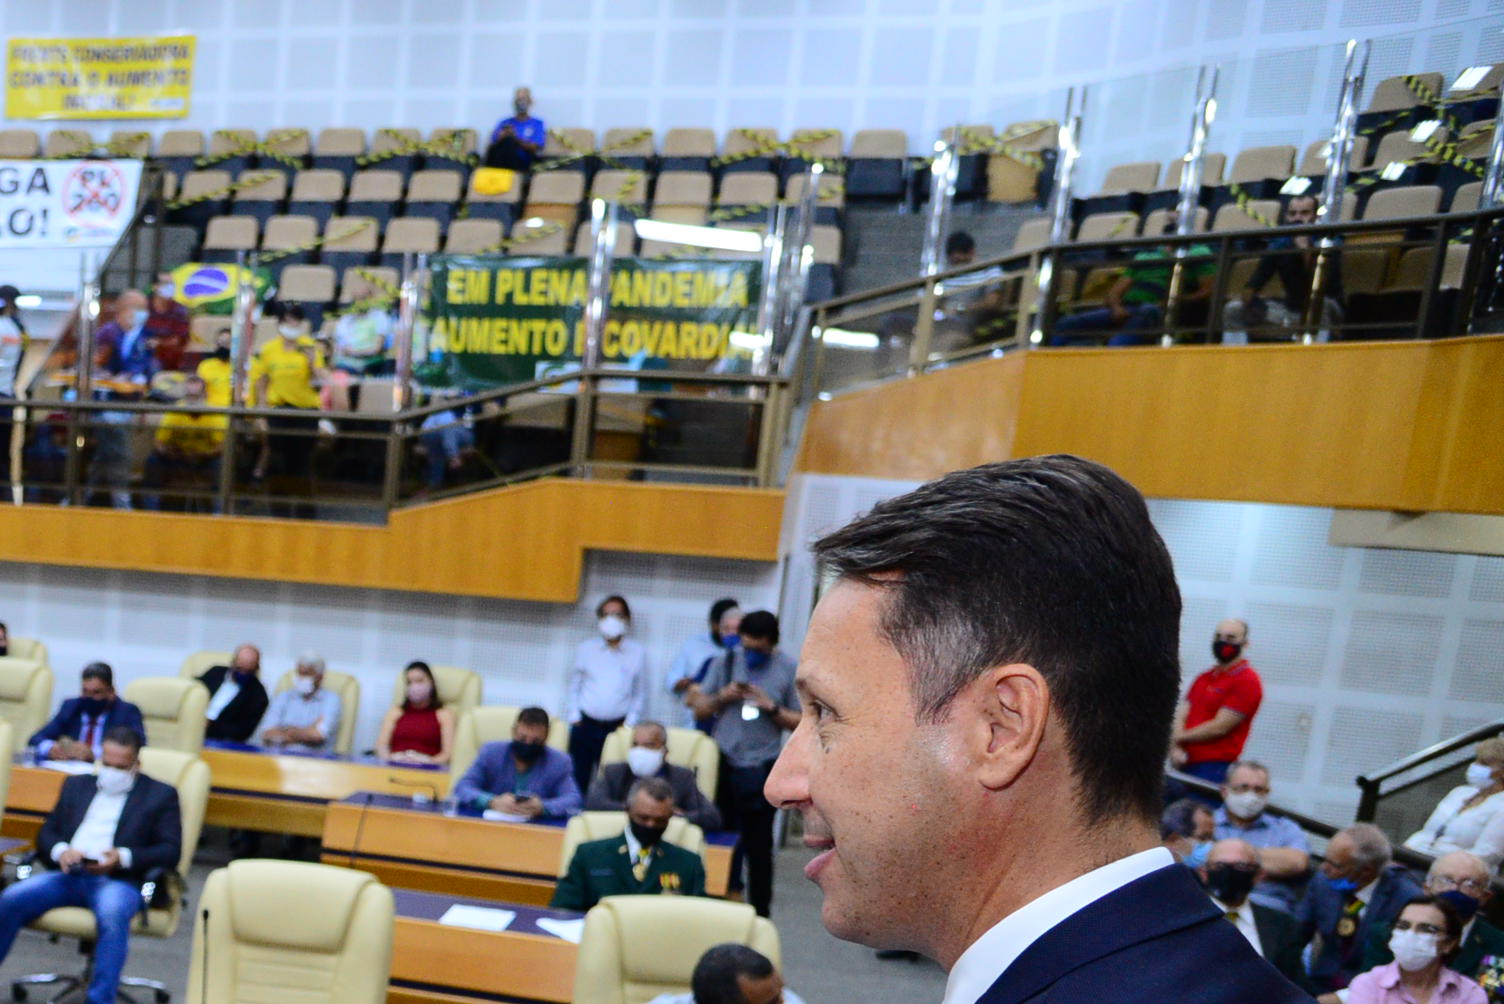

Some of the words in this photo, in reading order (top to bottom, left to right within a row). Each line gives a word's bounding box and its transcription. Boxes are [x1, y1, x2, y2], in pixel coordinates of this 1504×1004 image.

[447, 268, 491, 305] EM
[495, 268, 588, 307] PLENA
[429, 316, 568, 356] AUMENTO
